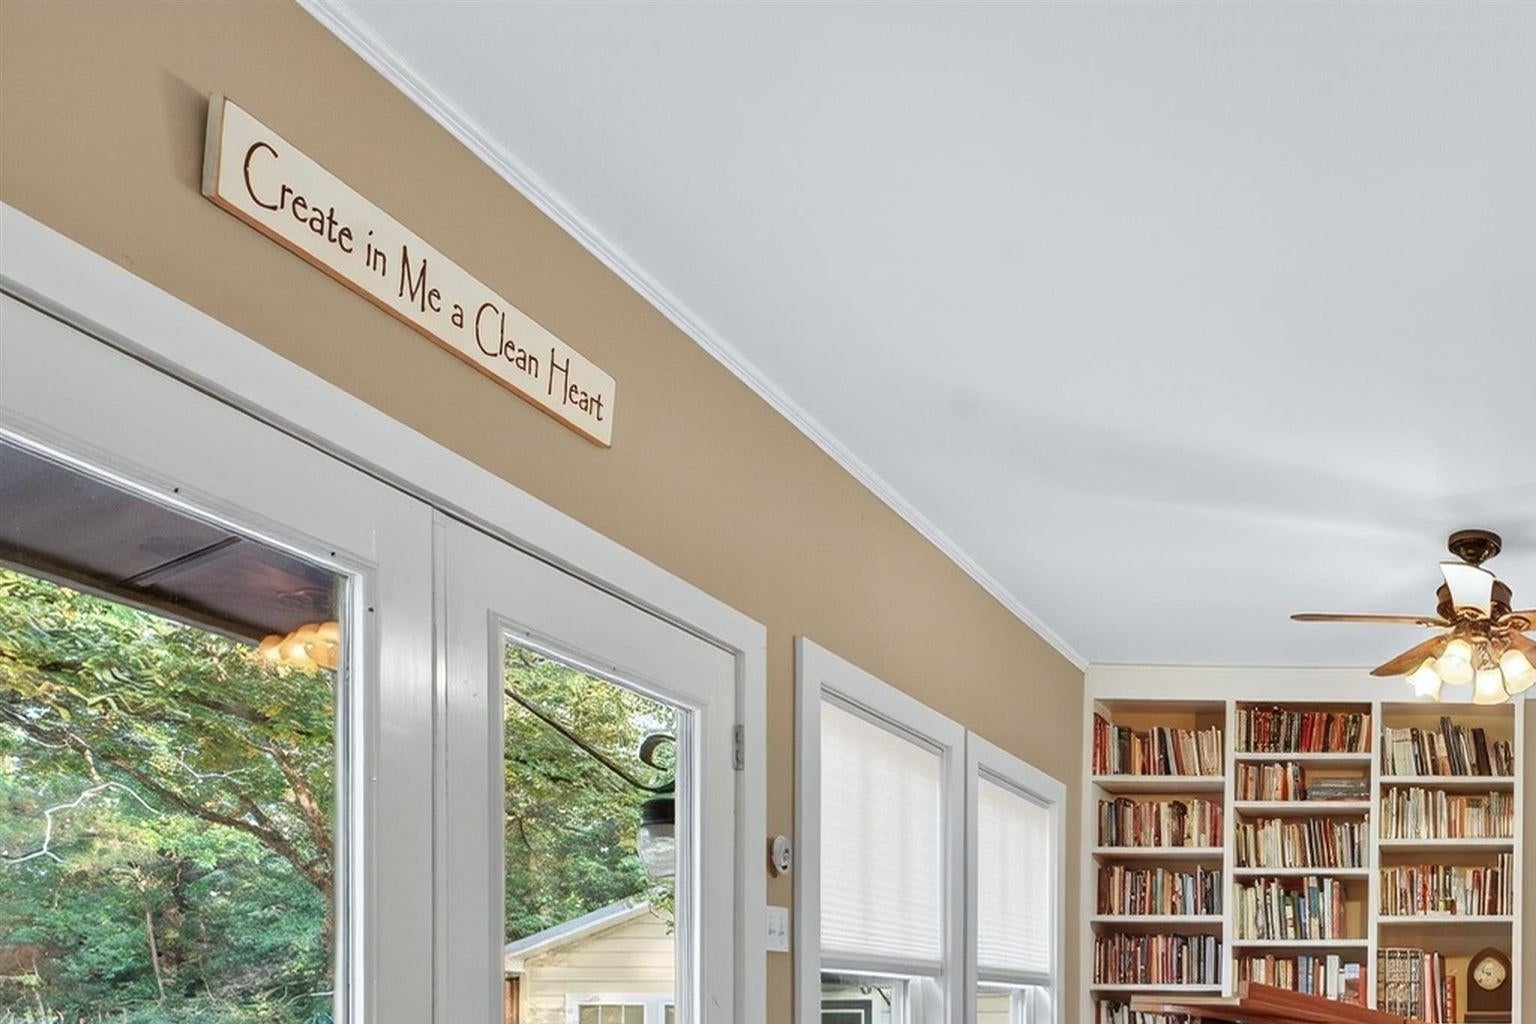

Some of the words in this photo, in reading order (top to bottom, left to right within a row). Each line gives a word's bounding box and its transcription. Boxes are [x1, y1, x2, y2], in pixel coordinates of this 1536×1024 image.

[243, 141, 353, 254] Create
[365, 231, 388, 276] in
[398, 245, 442, 313] Me
[451, 304, 464, 329] a
[474, 302, 540, 378] Clean
[547, 347, 605, 422] Heart
